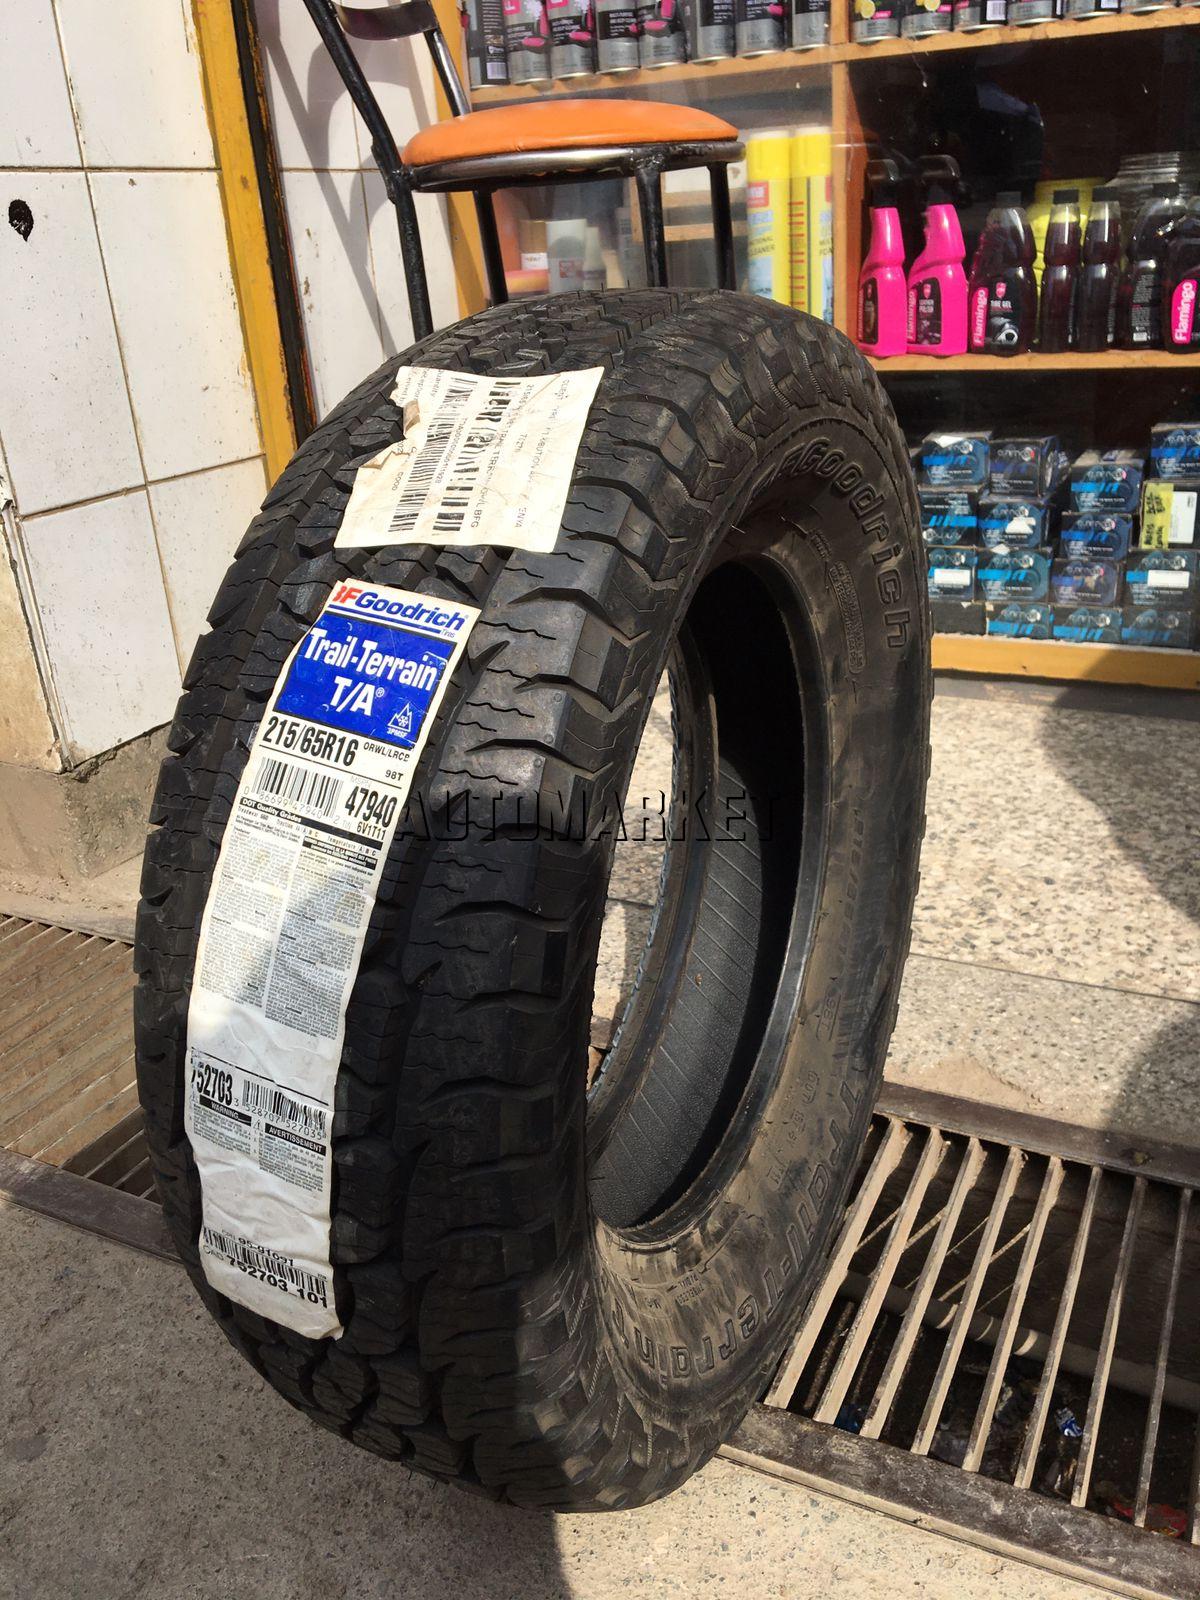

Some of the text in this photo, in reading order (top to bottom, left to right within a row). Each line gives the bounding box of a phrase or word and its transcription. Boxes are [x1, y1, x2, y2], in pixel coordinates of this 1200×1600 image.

[974, 289, 987, 344] Flamingo
[1174, 282, 1196, 341] Flamingo
[470, 509, 483, 529] BFG
[304, 627, 438, 691] Trail-Terrain
[262, 716, 359, 767] 215/65R16
[385, 769, 404, 781] 98T
[242, 798, 257, 808] DOT
[256, 802, 280, 817] Quality
[344, 786, 398, 828] 47940
[356, 821, 387, 841] 6V1T11
[211, 1101, 239, 1120] WARNING
[268, 1126, 323, 1152] AVERTISSEMENT
